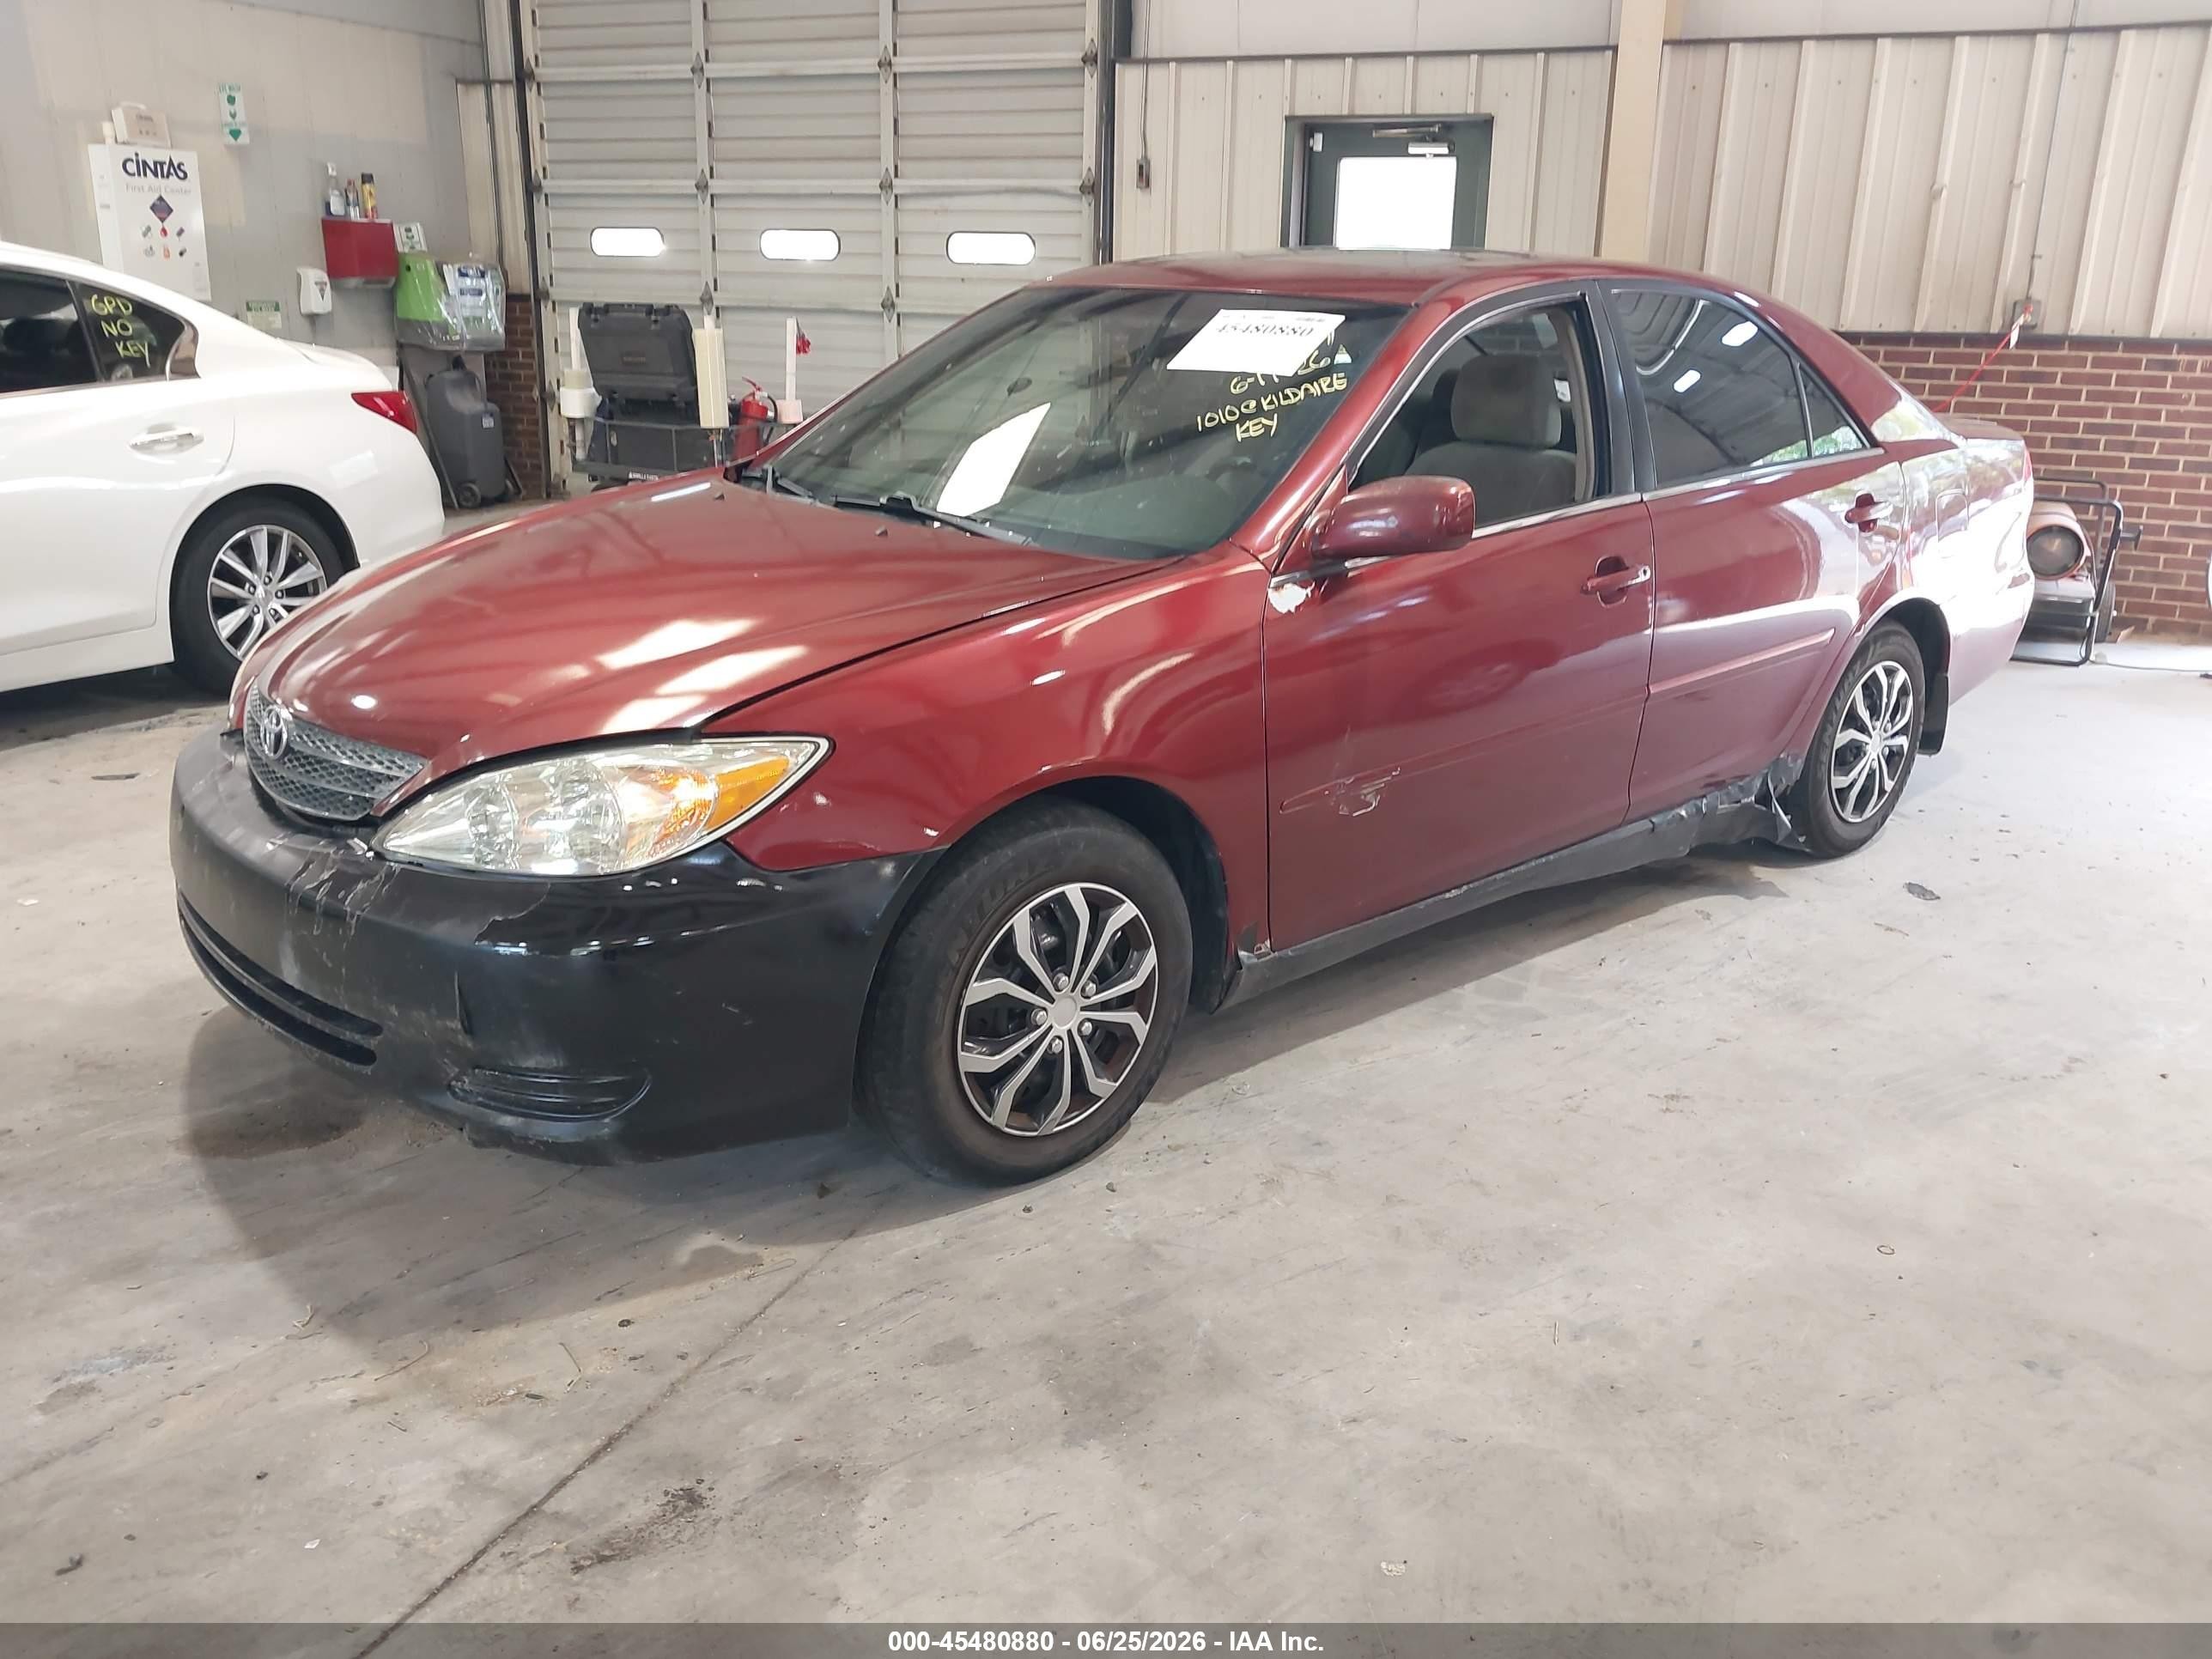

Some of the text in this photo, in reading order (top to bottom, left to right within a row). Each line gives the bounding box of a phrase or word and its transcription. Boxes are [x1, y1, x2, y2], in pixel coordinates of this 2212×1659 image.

[125, 183, 191, 195] First Aid Center
[91, 294, 132, 316] GPD
[100, 319, 132, 338] NO
[115, 340, 150, 368] KEY
[1197, 404, 1240, 432] 1010
[1261, 372, 1348, 412] KILDAIRE
[1236, 413, 1278, 442] KEY
